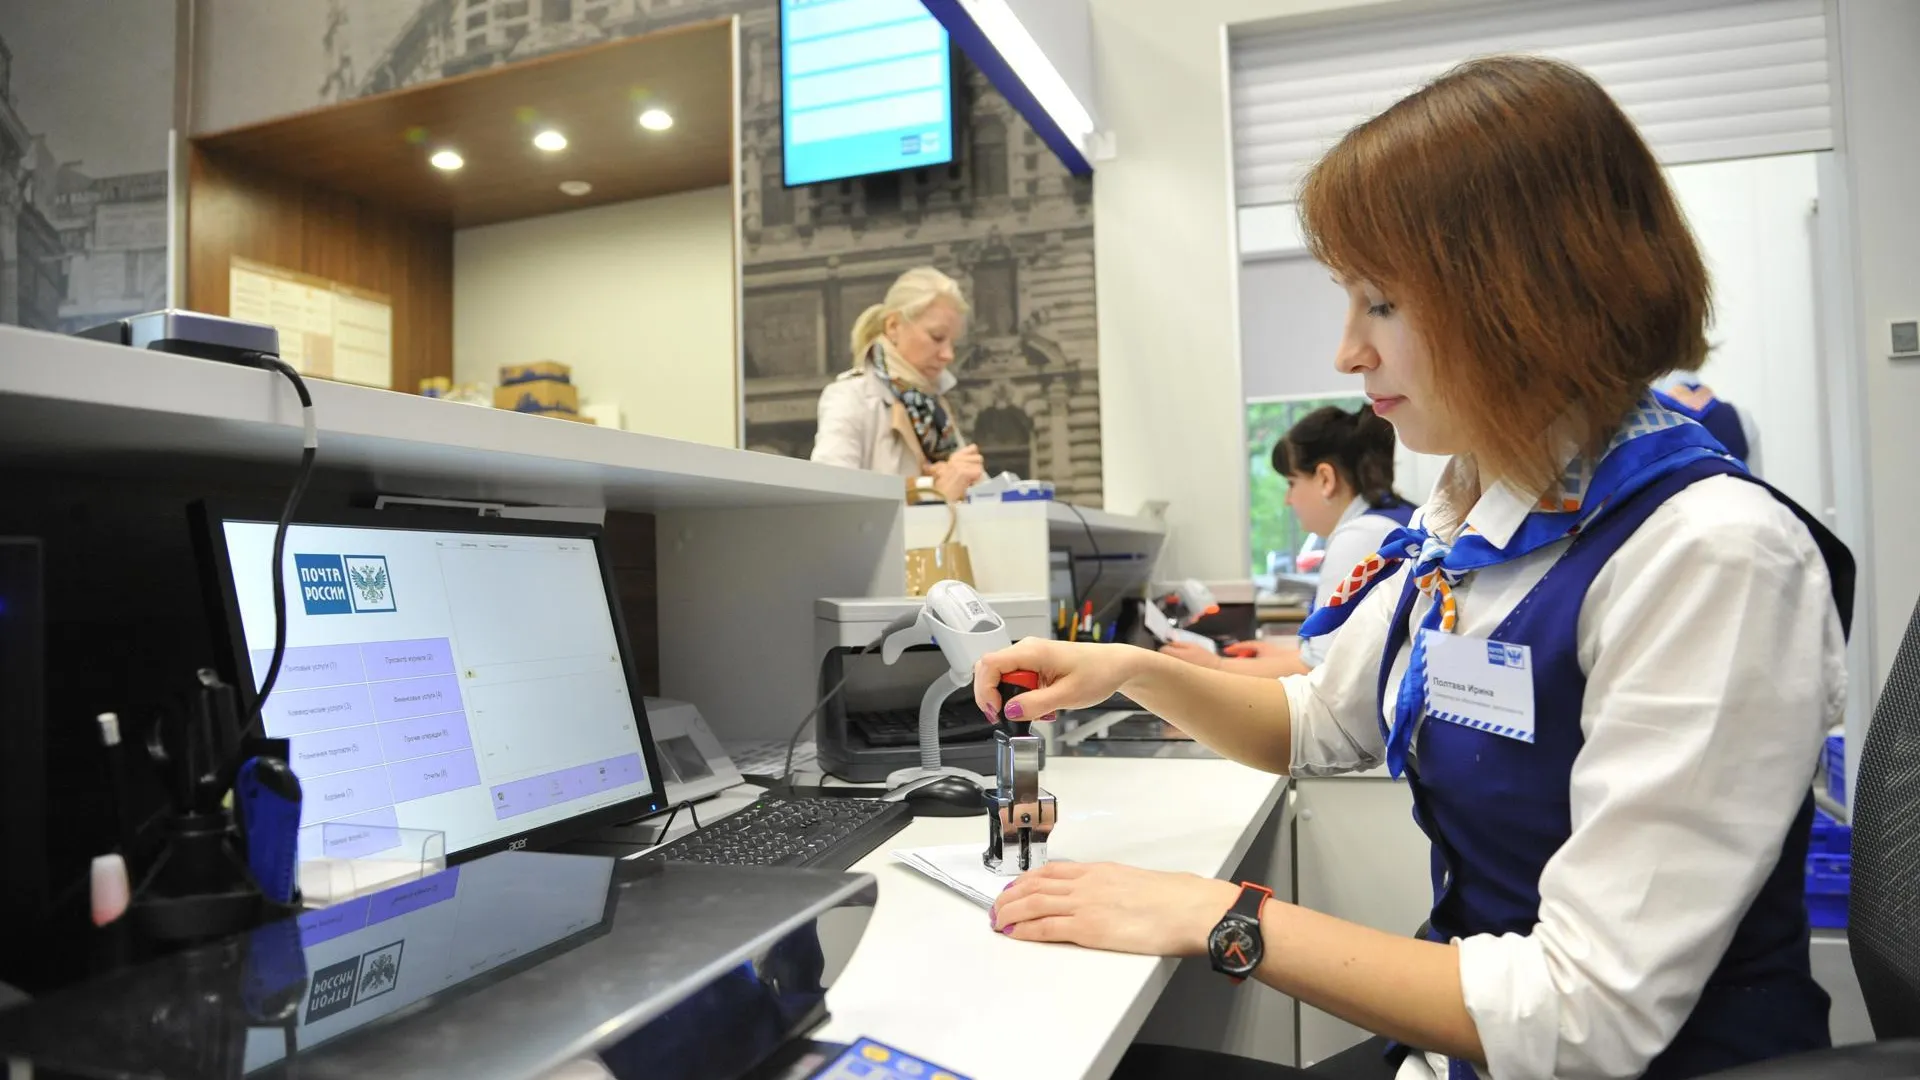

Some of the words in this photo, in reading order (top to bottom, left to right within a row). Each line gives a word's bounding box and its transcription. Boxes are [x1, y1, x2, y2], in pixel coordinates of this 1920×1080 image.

[301, 567, 342, 582] ПОЧТА
[304, 586, 346, 601] РОССИИ
[1433, 677, 1466, 692] Полтава
[1467, 684, 1495, 697] Ирина
[508, 837, 528, 851] acer
